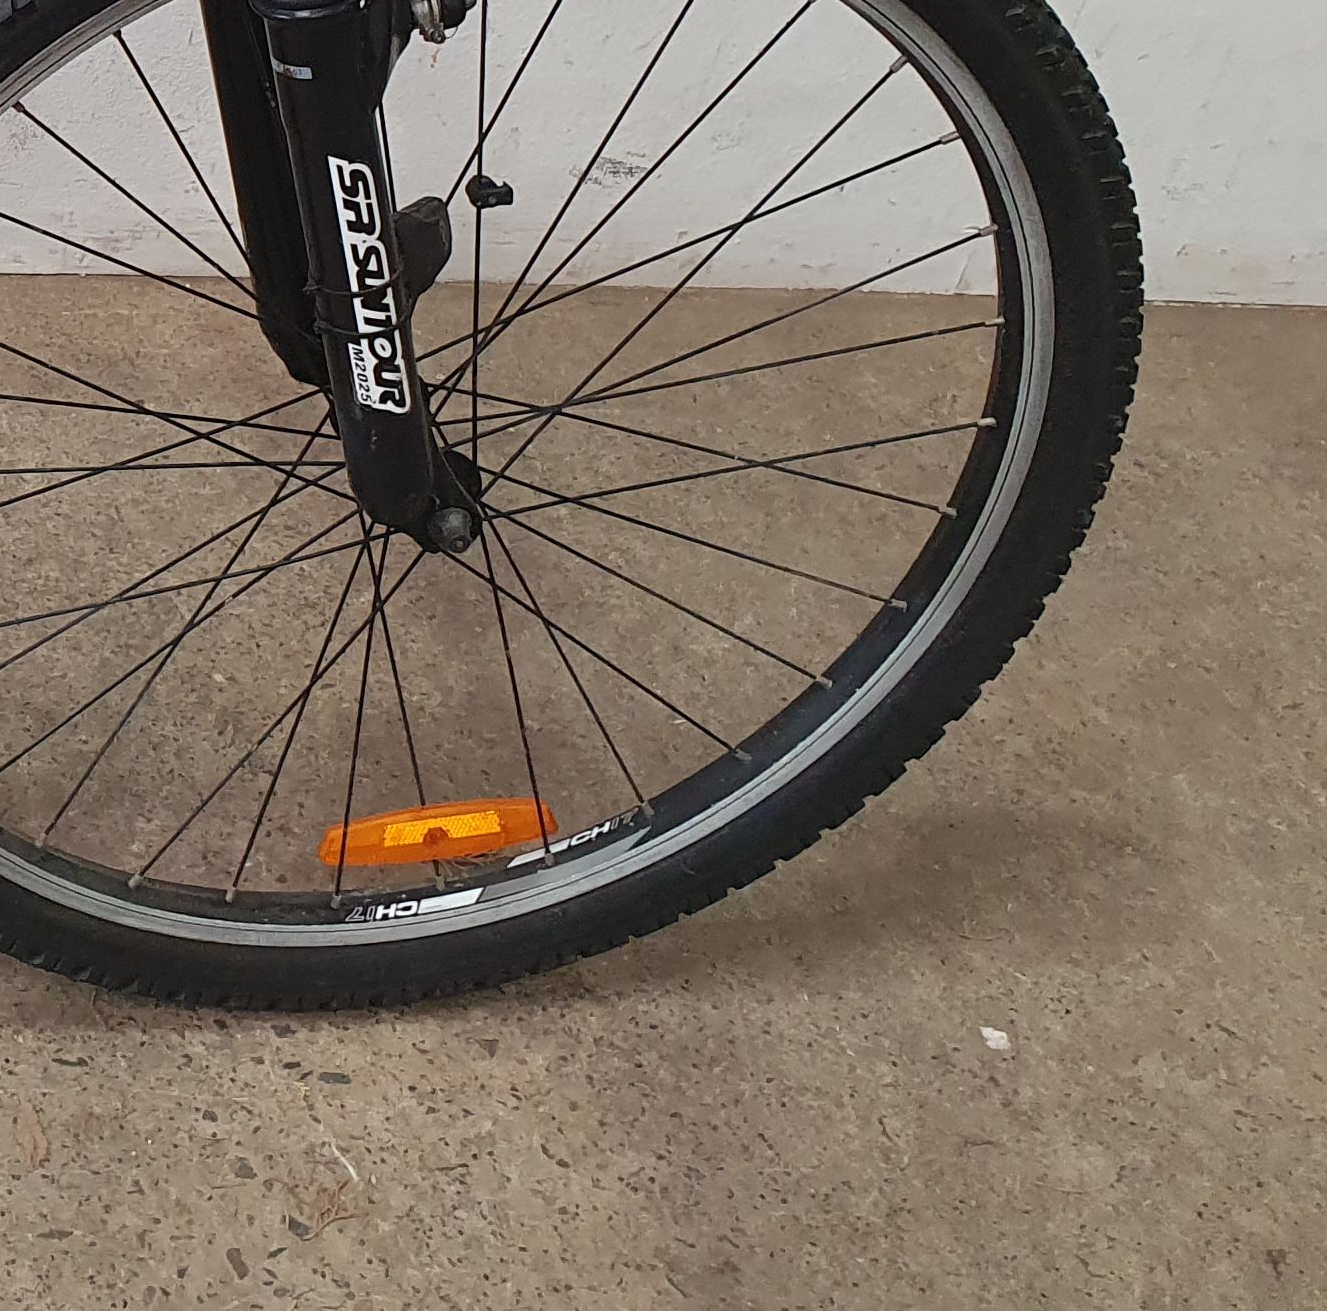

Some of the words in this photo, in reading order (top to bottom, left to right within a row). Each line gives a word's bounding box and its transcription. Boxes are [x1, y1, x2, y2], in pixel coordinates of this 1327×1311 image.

[336, 163, 376, 237] SR
[350, 243, 408, 409] SUNTOUR
[351, 346, 373, 403] M2025
